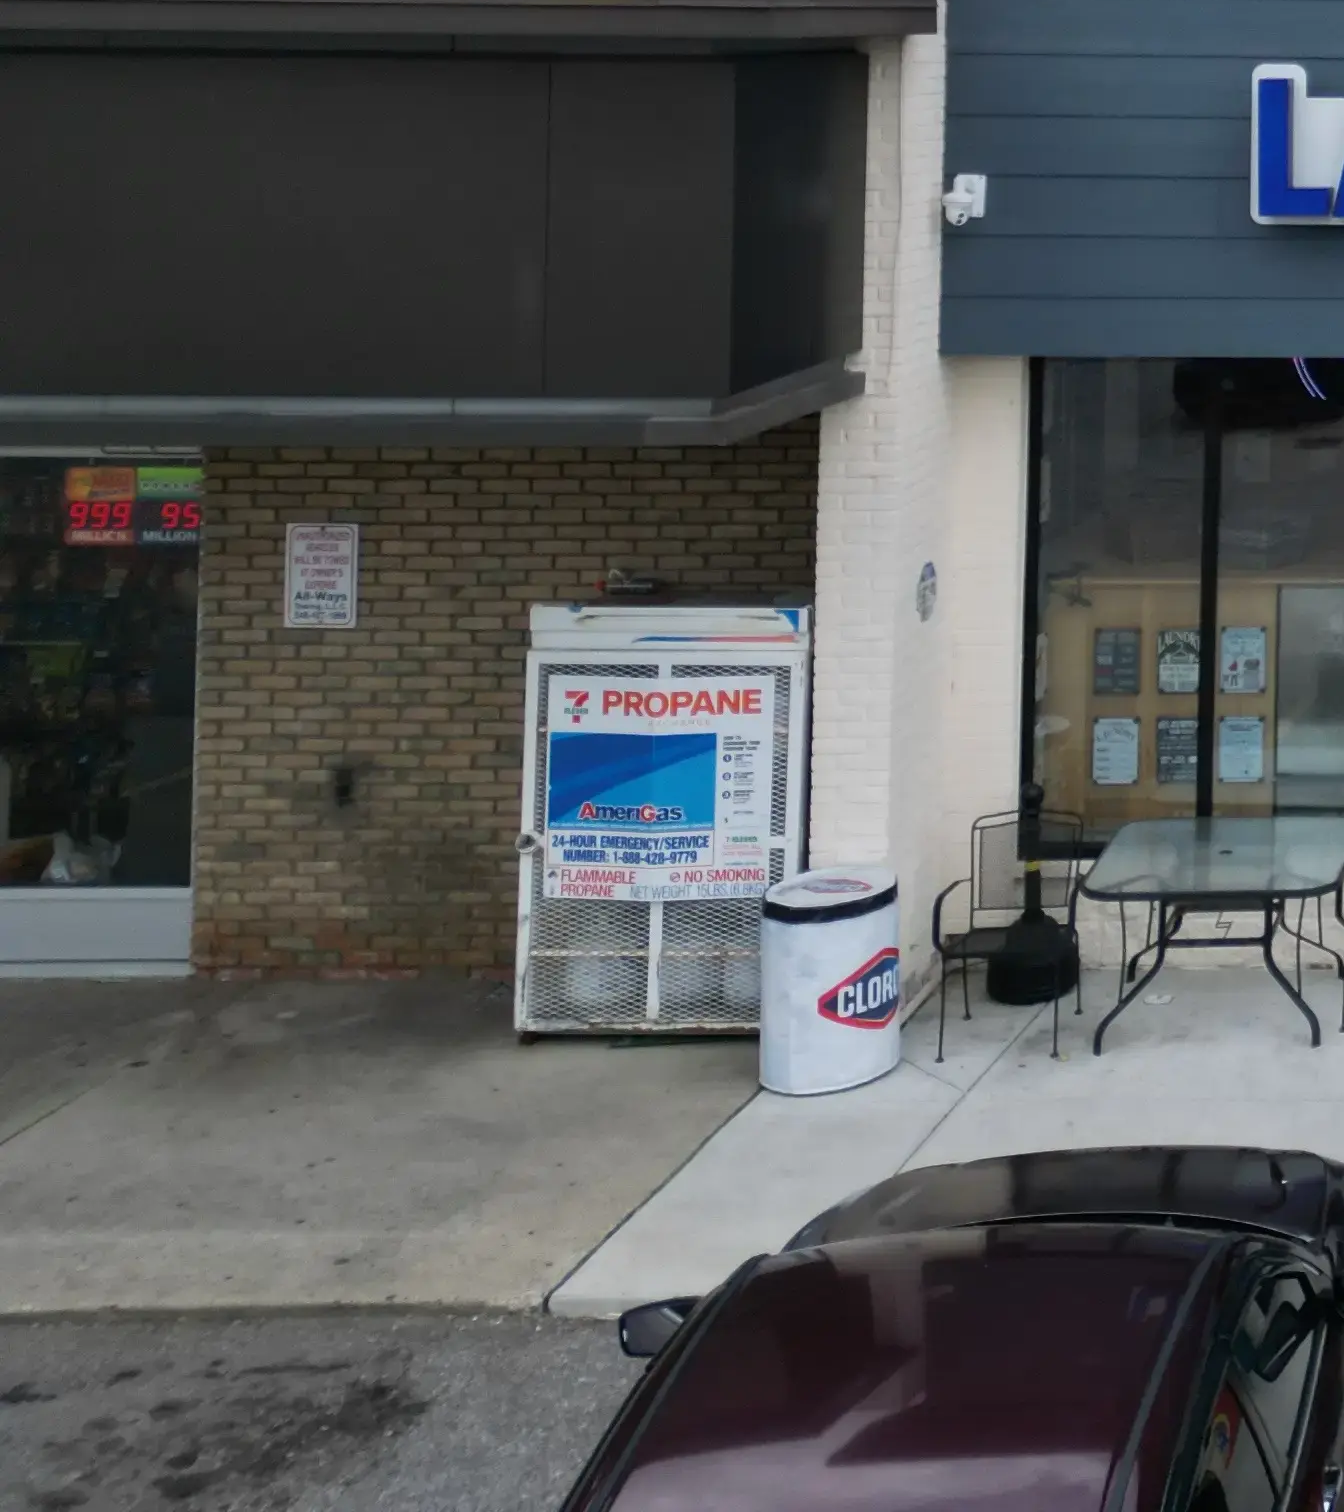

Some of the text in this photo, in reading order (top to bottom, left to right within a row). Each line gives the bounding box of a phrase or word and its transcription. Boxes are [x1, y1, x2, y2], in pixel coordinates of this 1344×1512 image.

[69, 502, 131, 528] 999
[160, 502, 200, 528] 95
[565, 690, 590, 724] 7
[602, 689, 762, 718] PROPANE
[579, 801, 683, 822] AmeriGas
[552, 835, 597, 849] 24-HOUR
[600, 835, 709, 851] EMERGENCY/SERVICE
[563, 849, 697, 865] NUMBER: 1-888-428-9779
[560, 869, 765, 884] FLAMMABLE NO SMOKING
[560, 884, 615, 897] PROPANE
[630, 885, 648, 899] NET
[652, 884, 692, 899] WEIGHT
[836, 963, 900, 1018] CLOR
